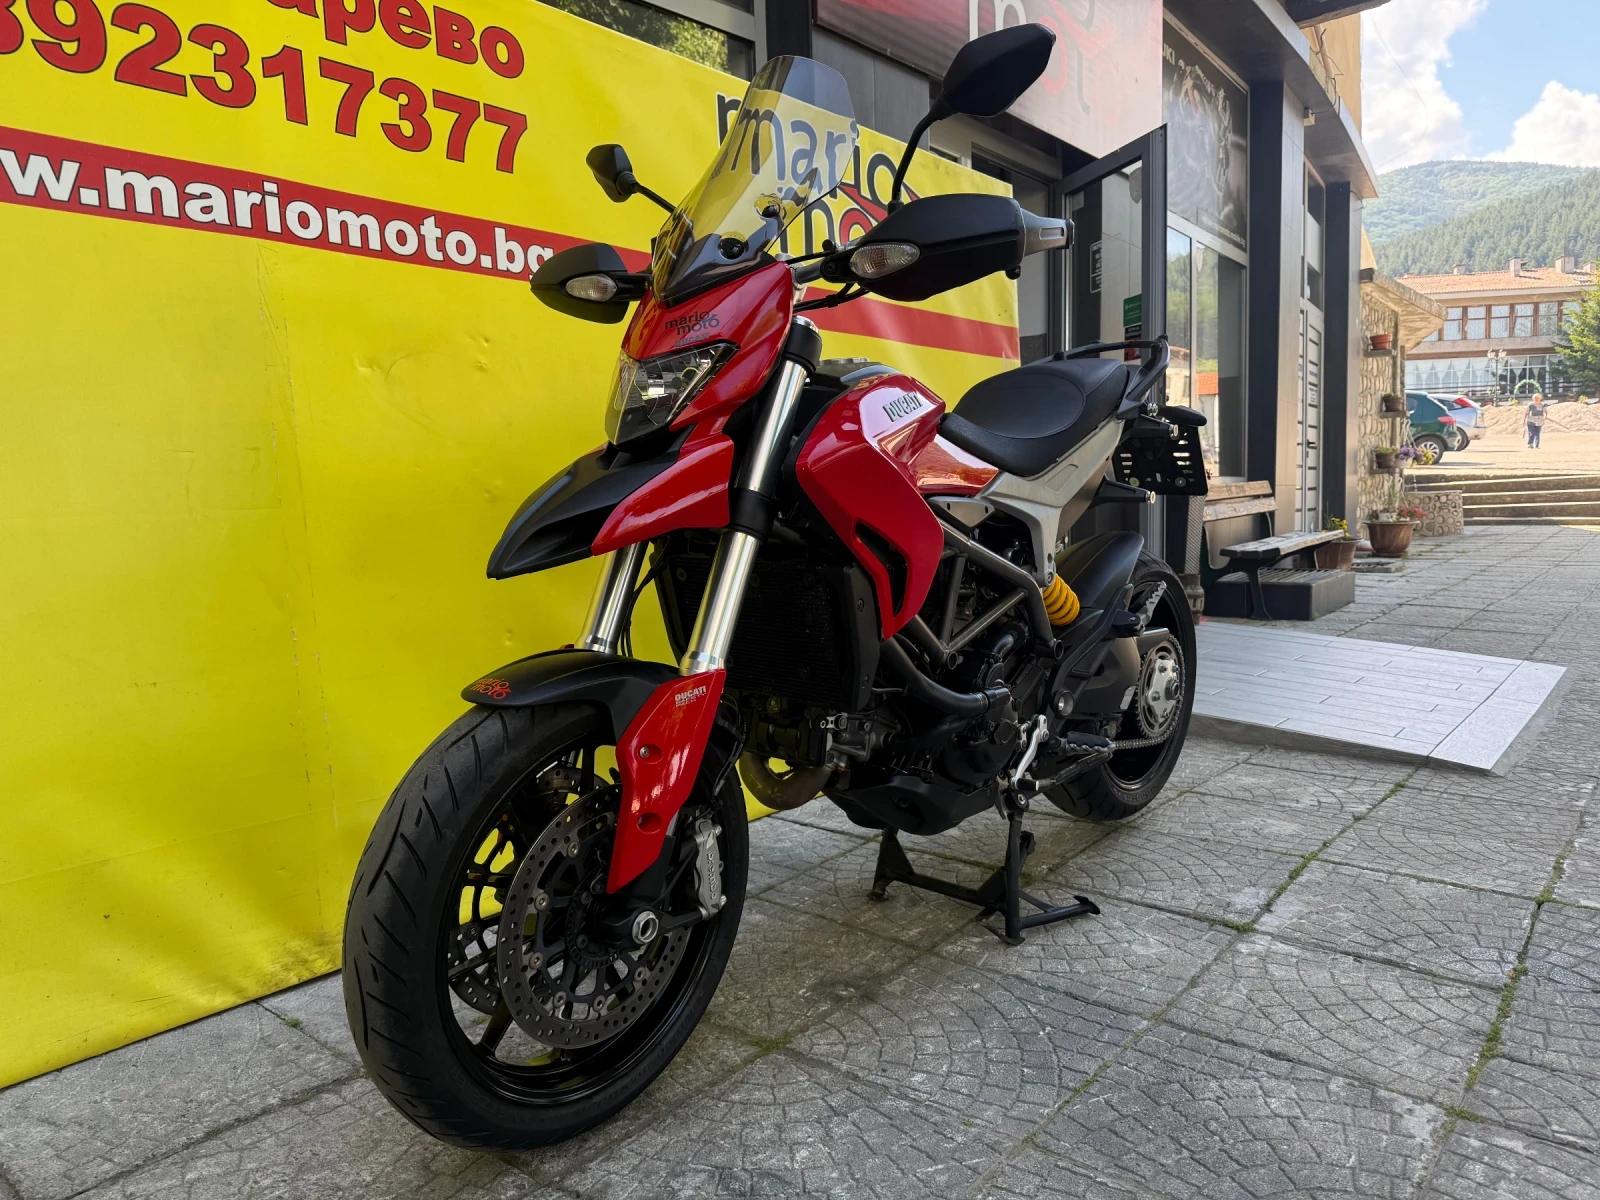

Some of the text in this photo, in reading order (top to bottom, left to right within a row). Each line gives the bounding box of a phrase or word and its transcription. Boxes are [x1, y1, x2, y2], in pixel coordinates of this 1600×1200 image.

[266, 0, 525, 78] рево
[0, 0, 528, 174] 92317377
[716, 92, 904, 206] mario
[664, 310, 710, 330] mario
[677, 314, 720, 336] moto
[469, 683, 512, 700] moto
[674, 685, 707, 701] DUCATI
[706, 850, 719, 900] brembo
